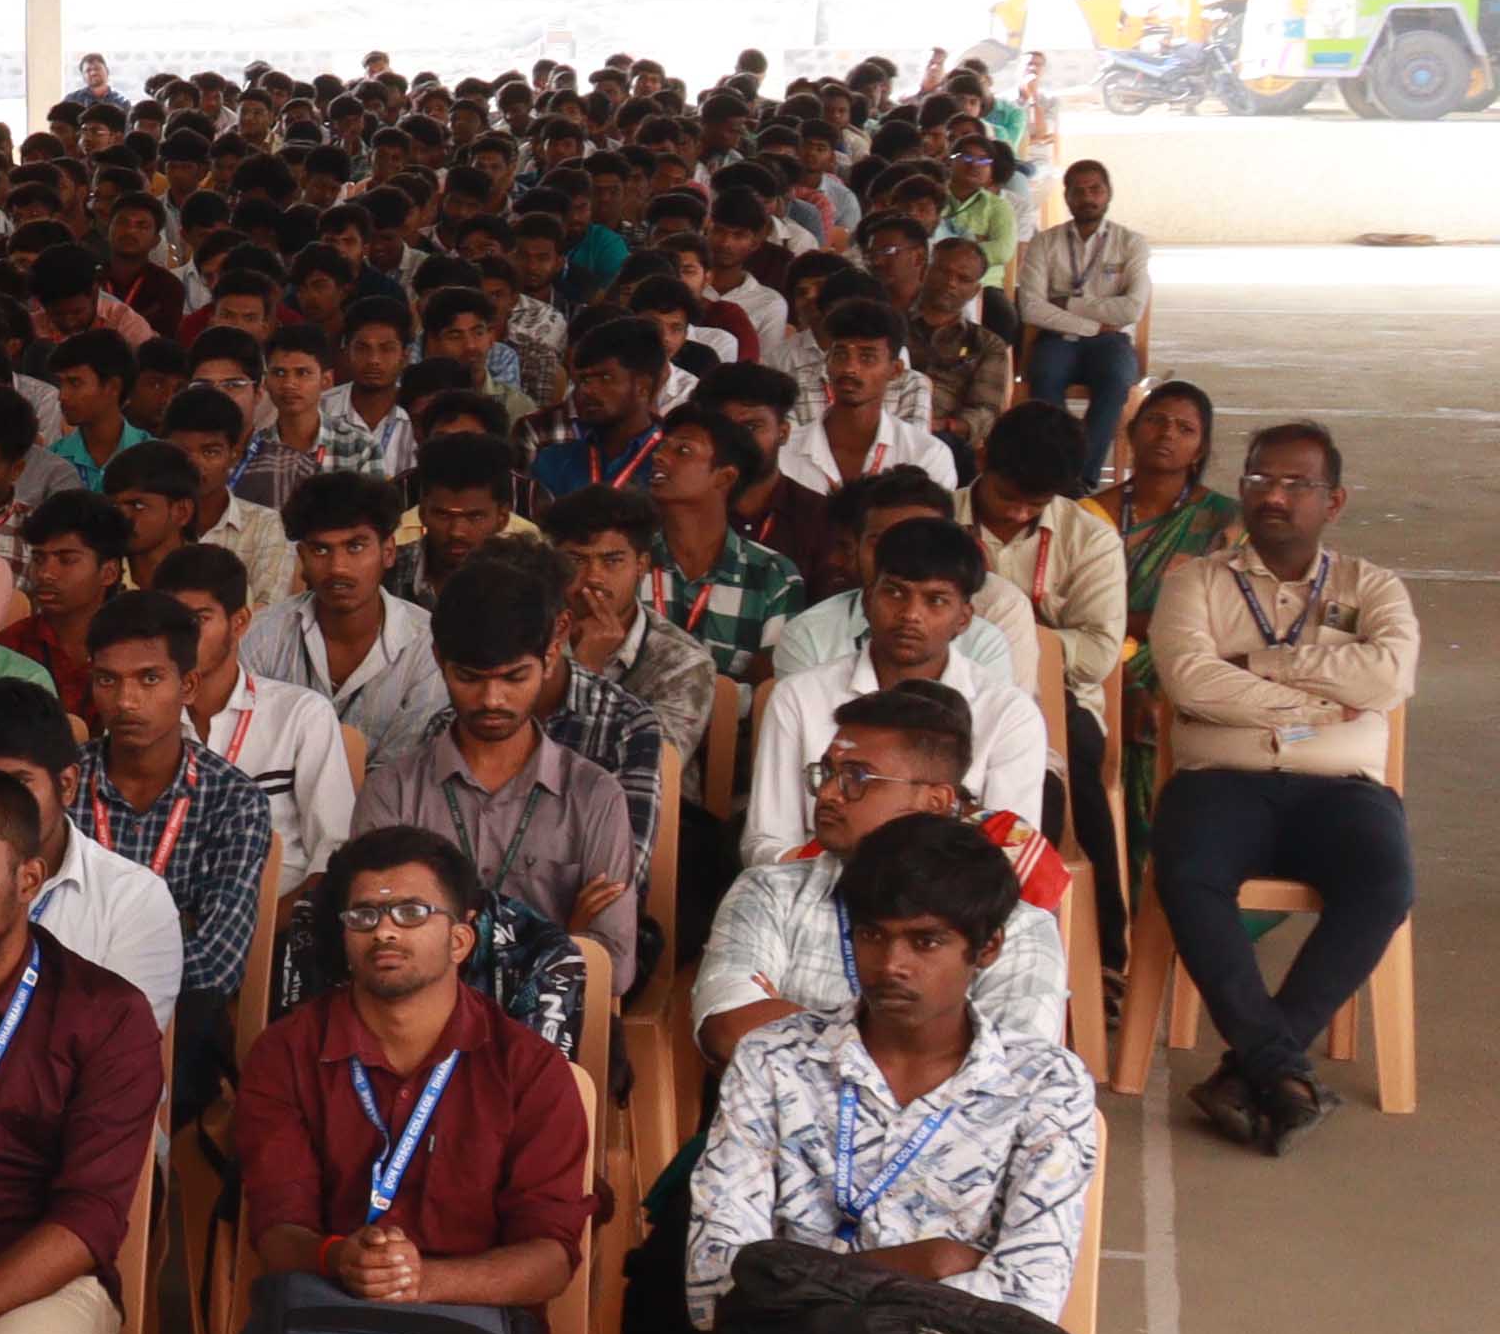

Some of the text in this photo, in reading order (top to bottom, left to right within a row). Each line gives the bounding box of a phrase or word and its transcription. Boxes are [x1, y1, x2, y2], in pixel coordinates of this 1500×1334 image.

[383, 1094, 435, 1190] DON BOSCO COLLEGE
[836, 1106, 852, 1187] BOSCO COLLEGE
[854, 1123, 932, 1211] DON BOSCO COLLEGE
